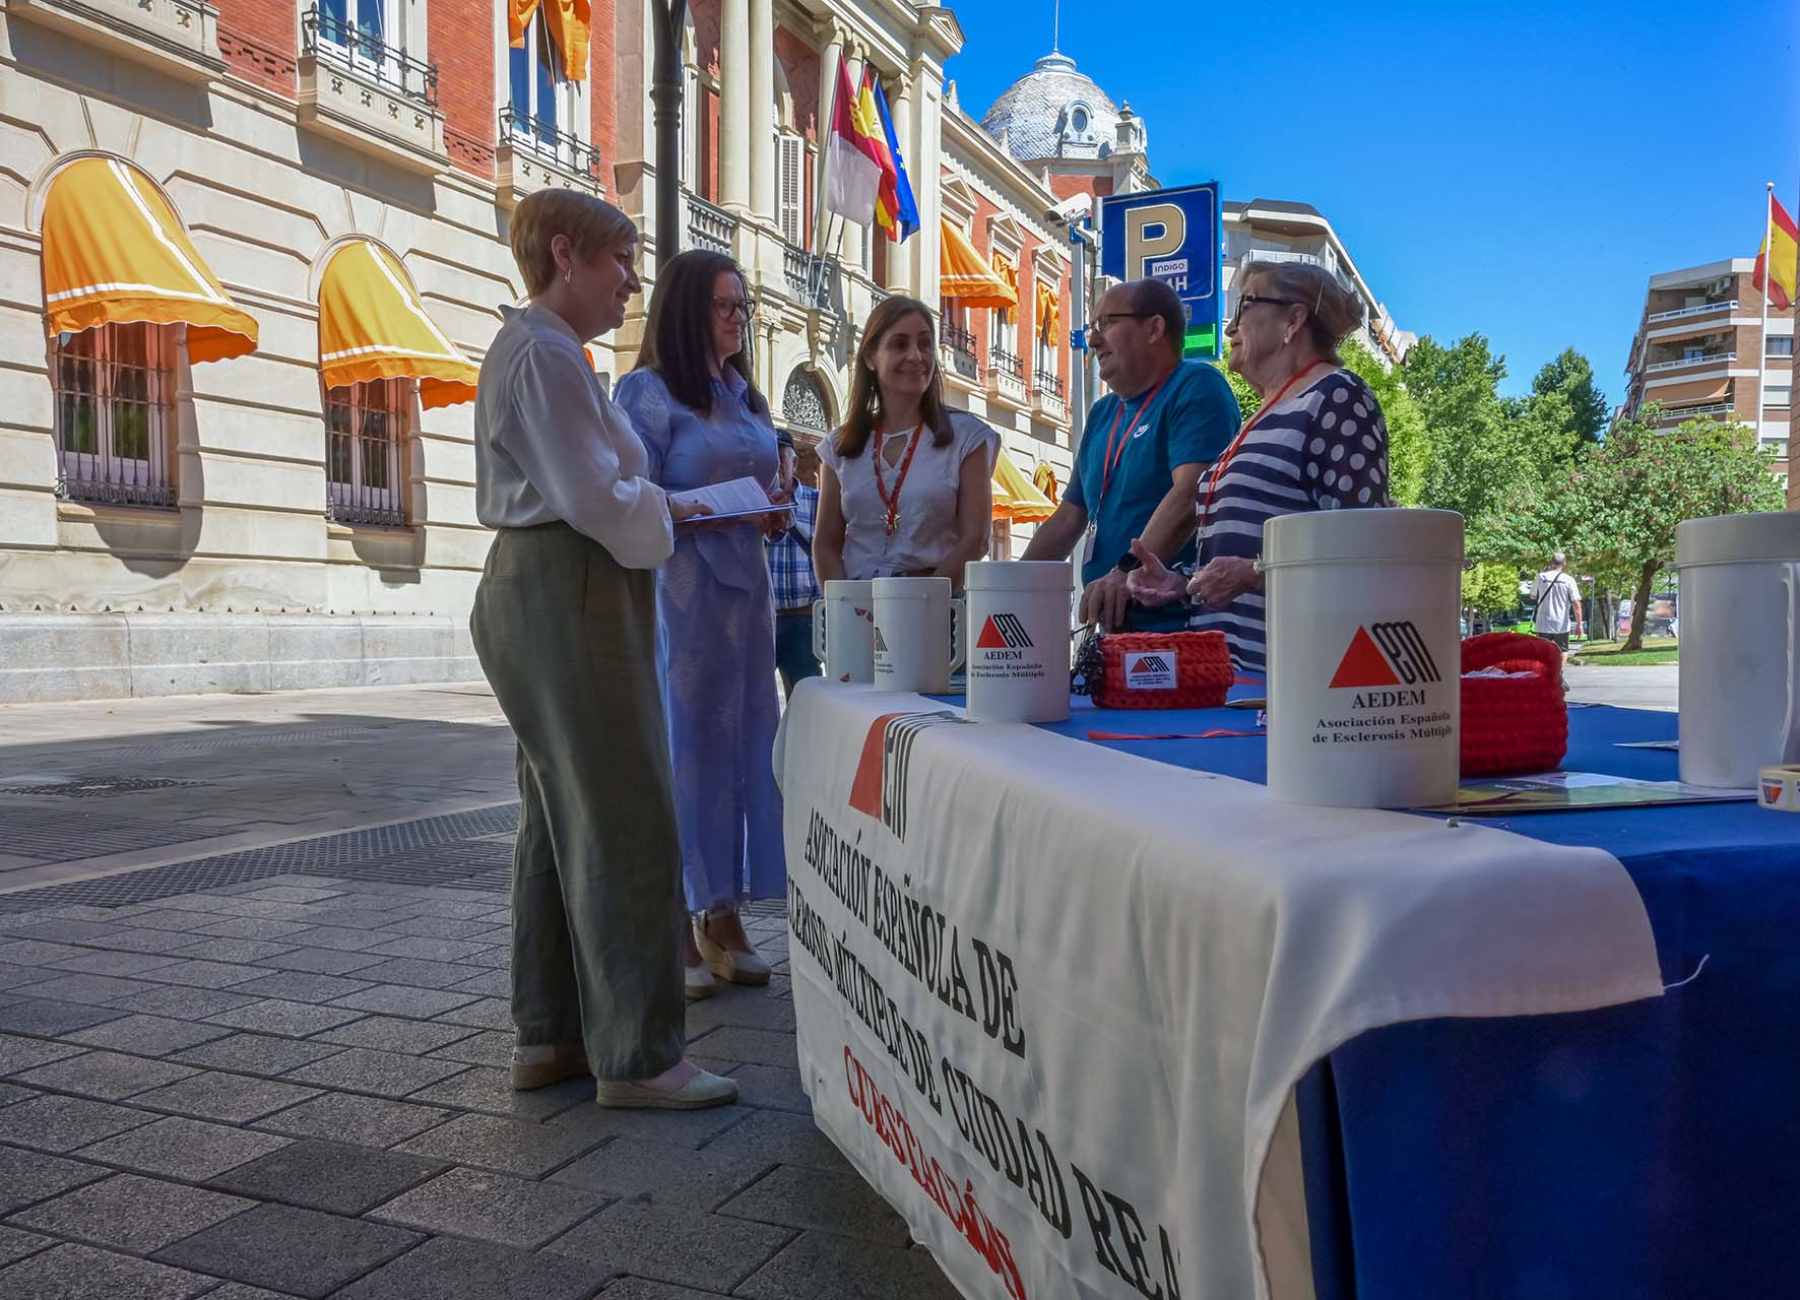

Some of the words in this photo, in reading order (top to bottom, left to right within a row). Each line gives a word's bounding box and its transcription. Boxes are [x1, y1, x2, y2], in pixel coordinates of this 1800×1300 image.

[1125, 203, 1186, 283] P
[1154, 262, 1185, 273] INDIGO
[984, 650, 1023, 660] AEDEM
[1352, 689, 1426, 709] AEDEM
[1316, 716, 1395, 729] Asociación
[1400, 711, 1451, 726] Española
[1312, 733, 1328, 743] de
[1333, 730, 1406, 743] Esclerosis
[805, 807, 871, 926] ASOCIACIÓN
[874, 865, 977, 1023] ESPAÑOLA
[972, 938, 1026, 1059] DE
[901, 1016, 943, 1116] DE
[942, 1057, 1072, 1239] CIUDAD
[1071, 1162, 1182, 1300] REA
